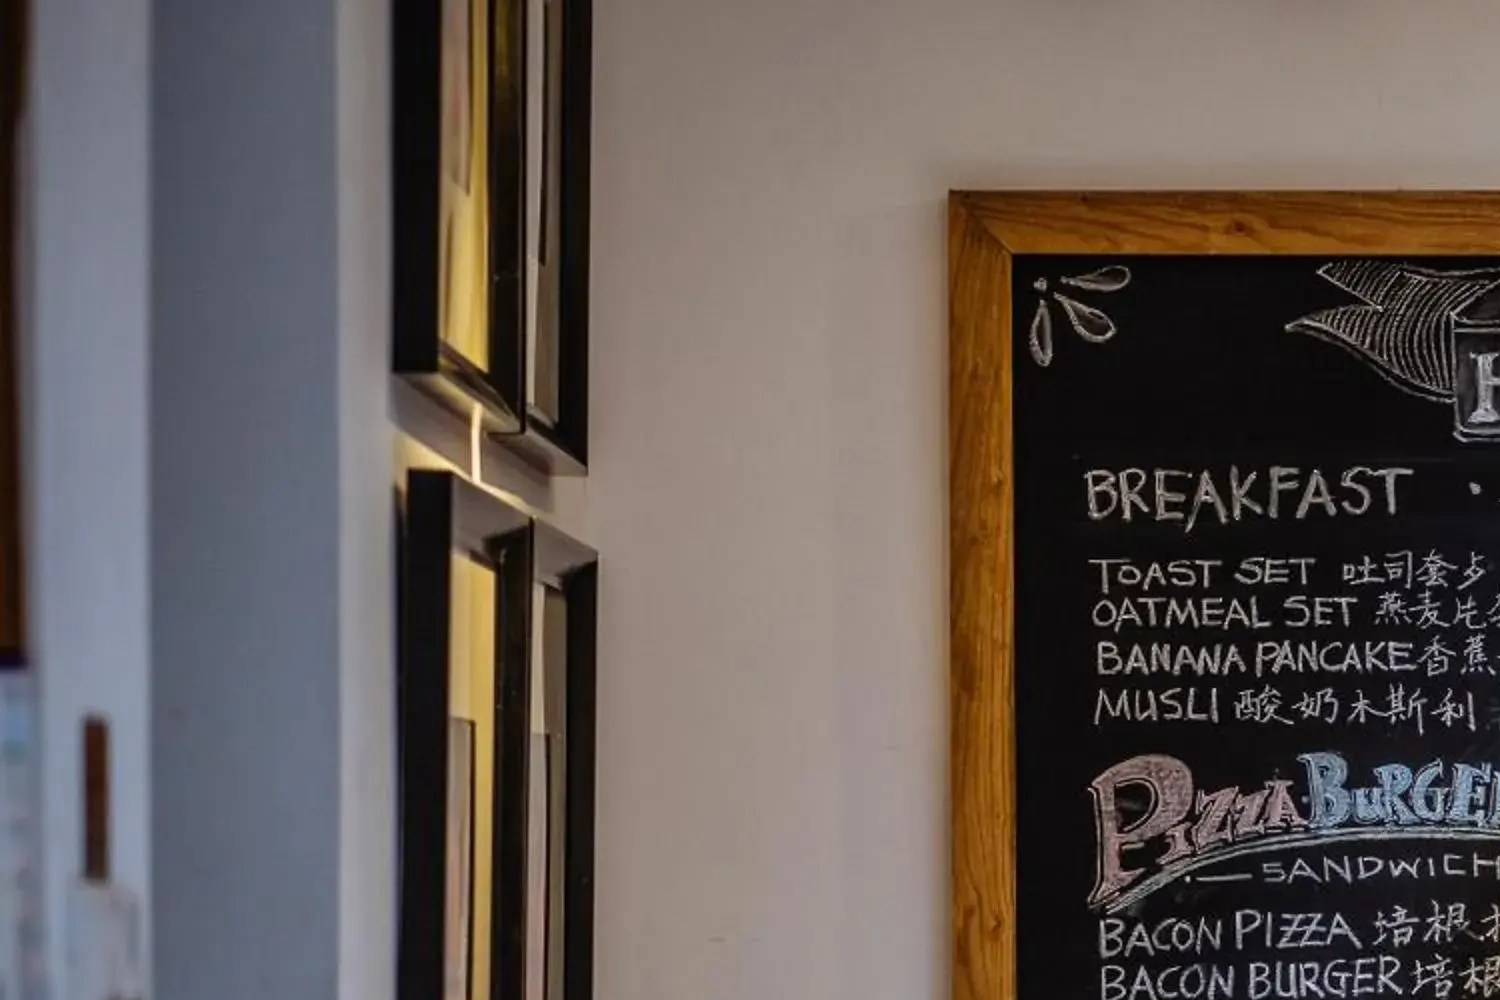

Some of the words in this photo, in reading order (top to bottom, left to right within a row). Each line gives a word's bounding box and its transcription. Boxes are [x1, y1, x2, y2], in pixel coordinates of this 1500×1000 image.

[1084, 464, 1414, 533] BREAKFAST
[1088, 558, 1222, 594] TOAST
[1234, 556, 1316, 586] SET
[1091, 595, 1272, 633] OATMEAL
[1283, 595, 1358, 628] SET
[1097, 641, 1247, 676] BANANA
[1254, 639, 1418, 678] PANCAKE
[1094, 686, 1219, 726] MUSLI
[1100, 918, 1222, 957] BACON
[1235, 909, 1362, 949] PIZZA
[1248, 955, 1403, 1000] BURGER
